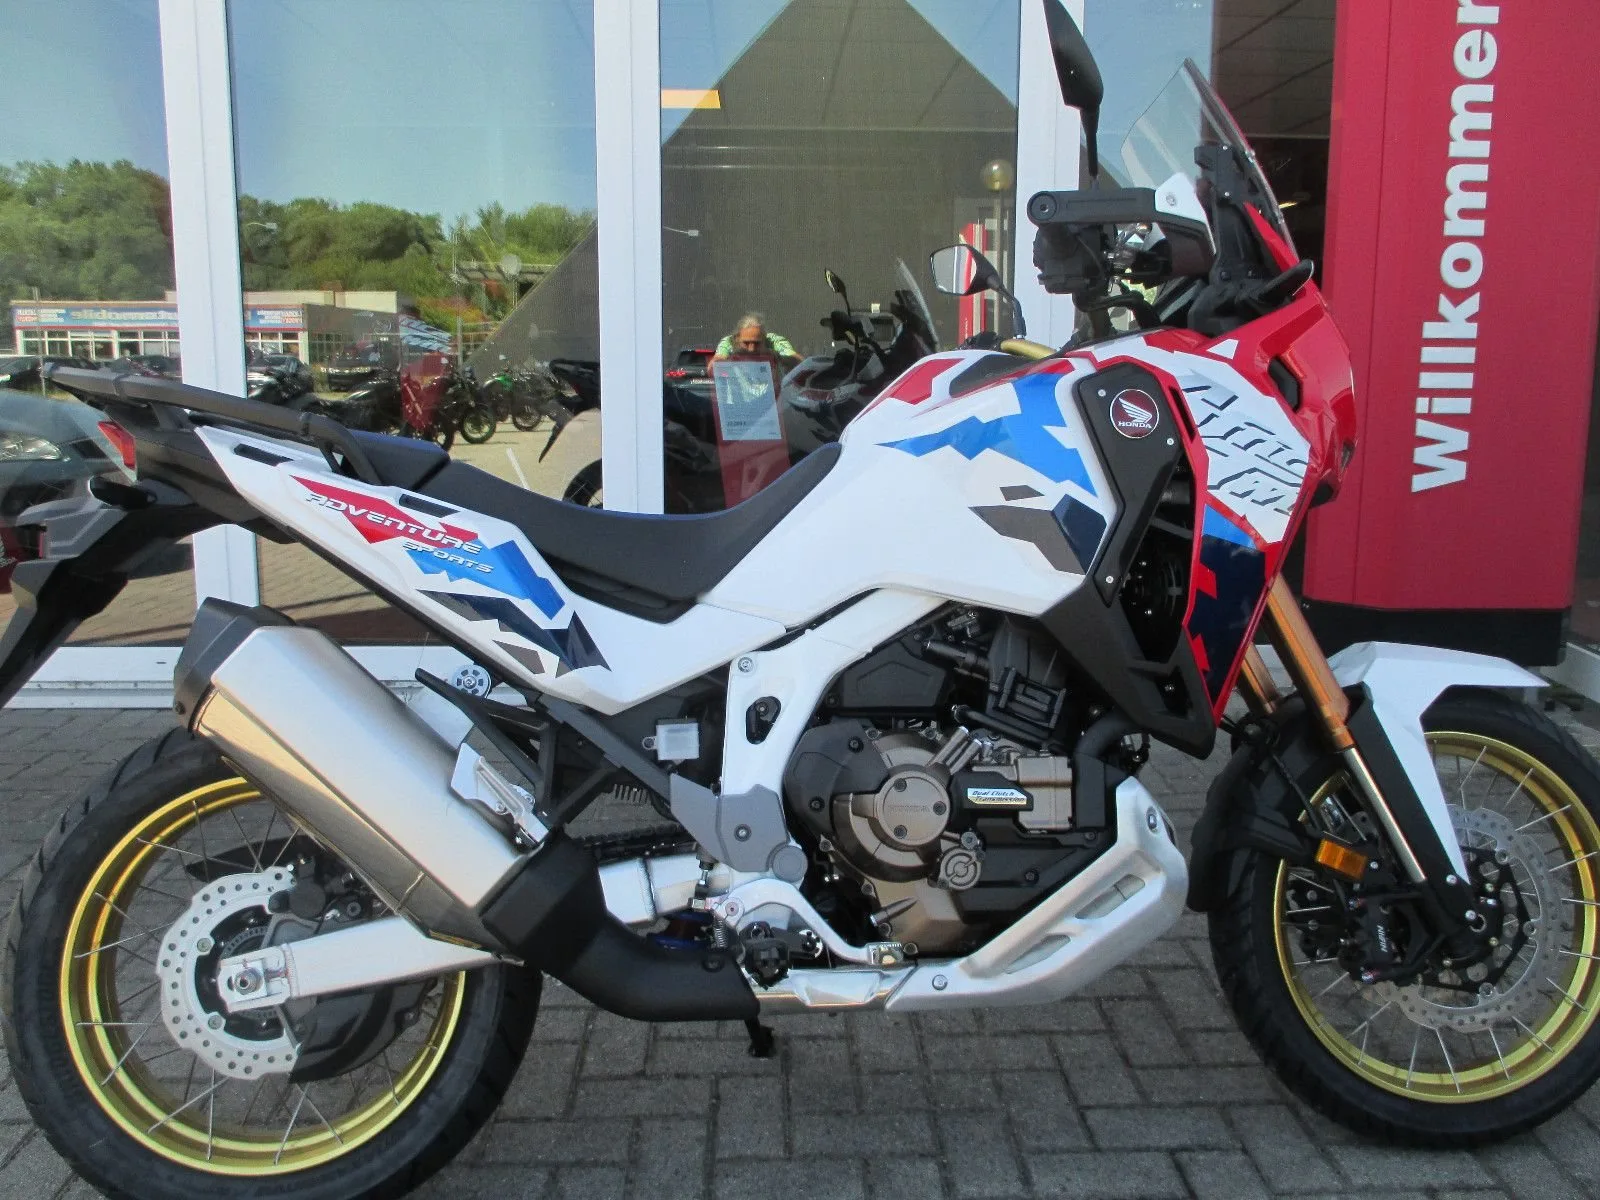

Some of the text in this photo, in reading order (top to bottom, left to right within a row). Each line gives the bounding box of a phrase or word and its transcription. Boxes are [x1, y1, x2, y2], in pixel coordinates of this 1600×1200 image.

[1117, 420, 1153, 429] HONDA
[305, 493, 483, 555] ADVENTURE
[402, 539, 494, 574] SPORTS
